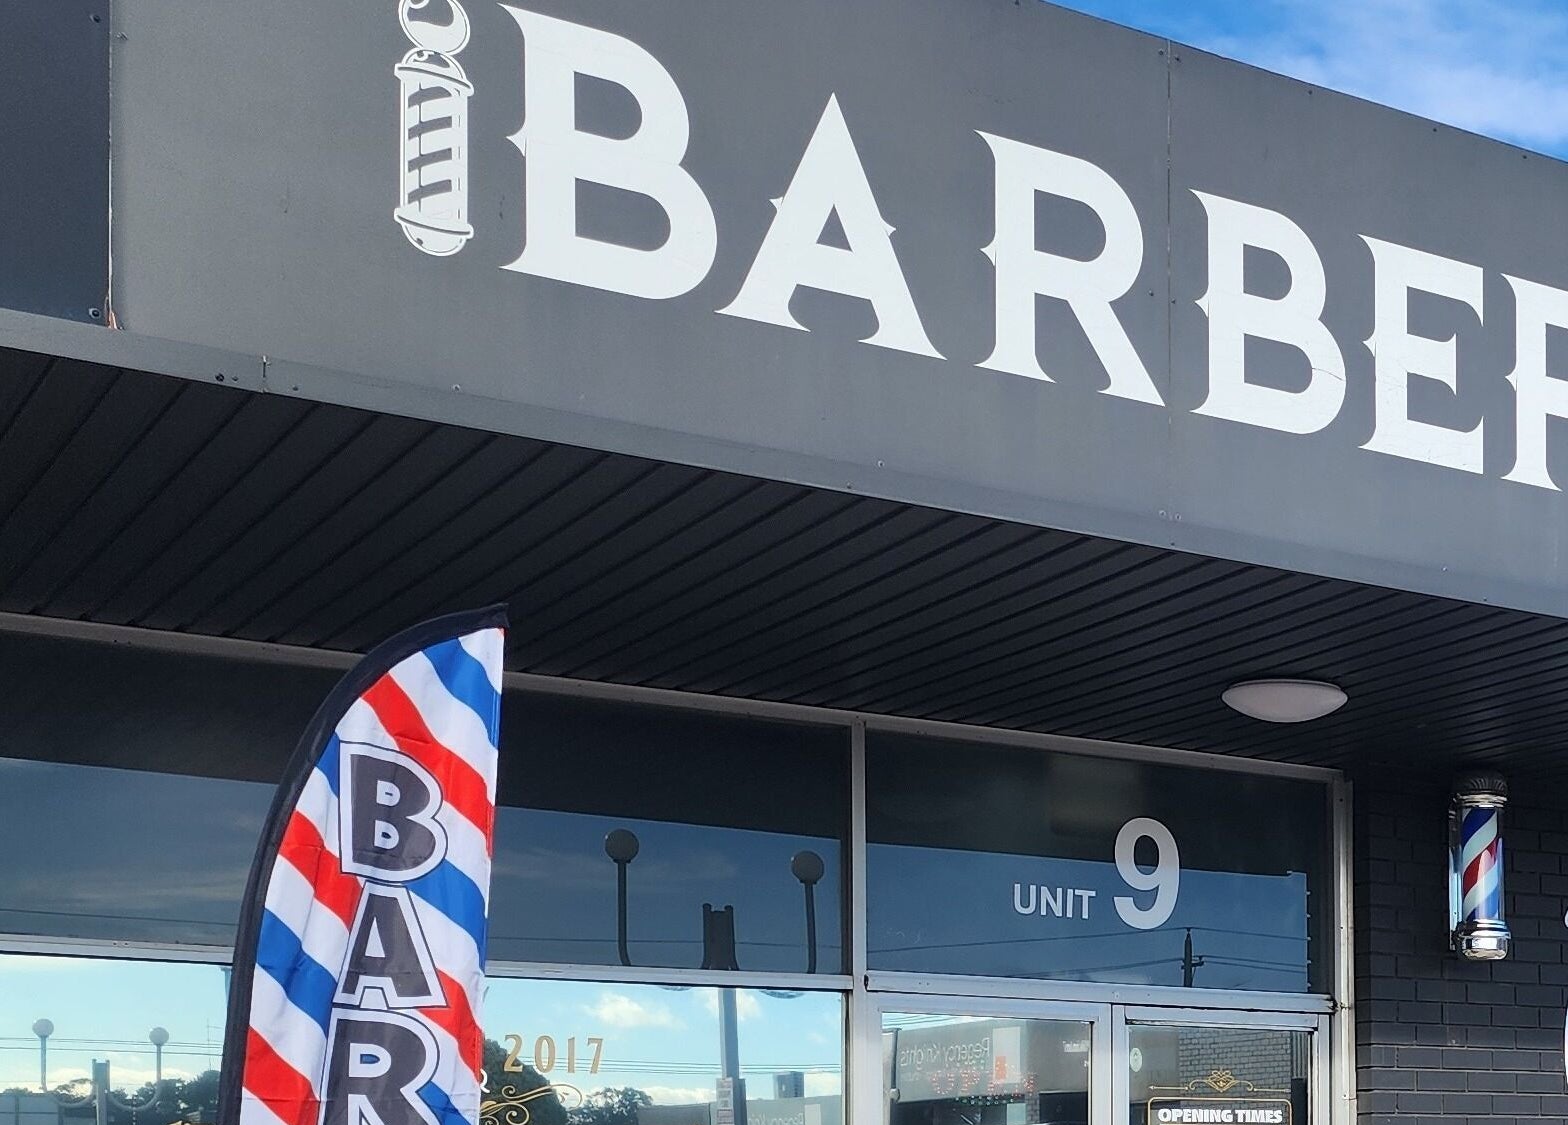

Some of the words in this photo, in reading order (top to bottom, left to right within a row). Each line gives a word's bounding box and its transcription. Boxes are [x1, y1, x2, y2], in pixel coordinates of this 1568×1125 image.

[1113, 817, 1180, 930] 9
[1013, 882, 1097, 920] UNIT
[503, 1033, 604, 1075] 2017
[1157, 1108, 1233, 1123] OPENING
[1235, 1109, 1283, 1124] TIMES
